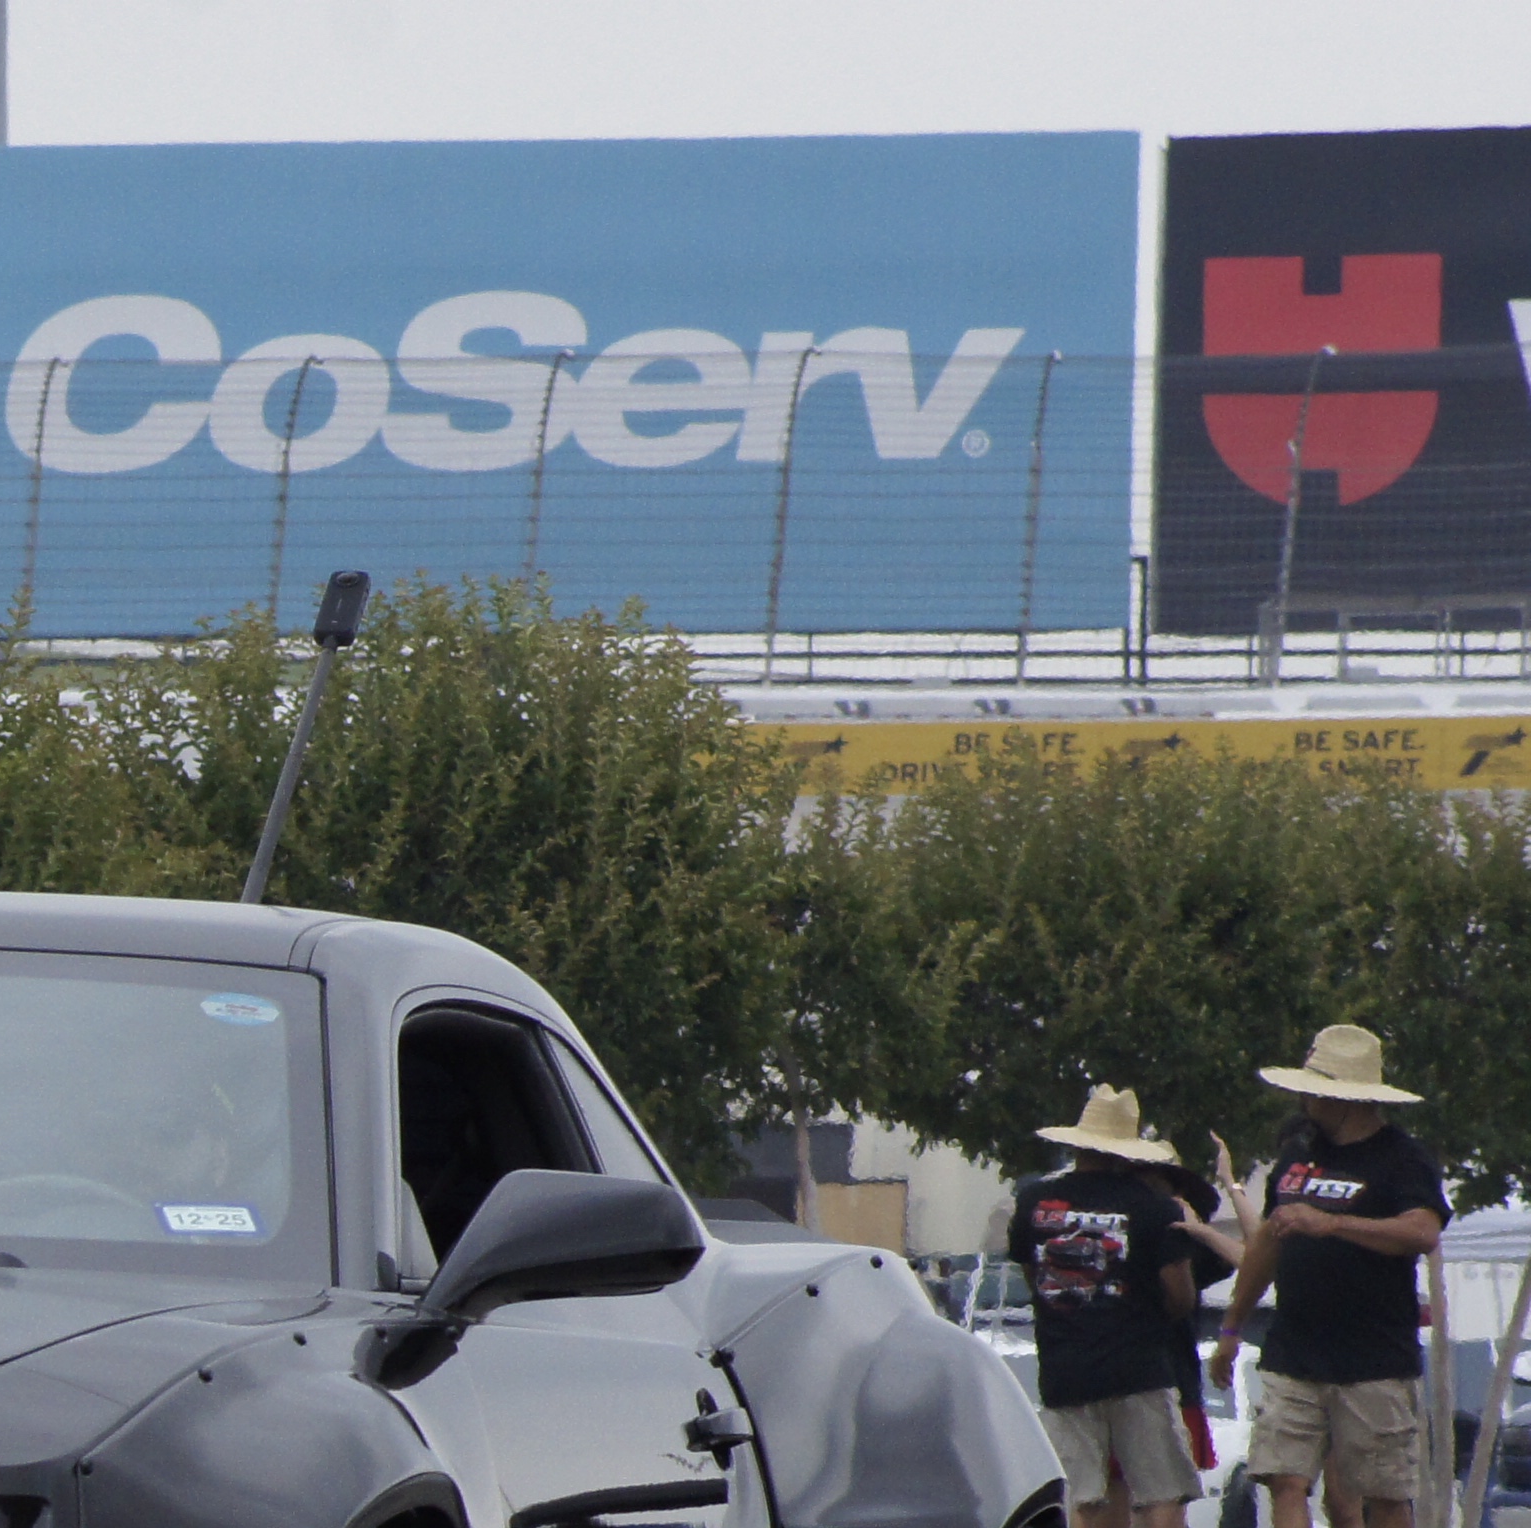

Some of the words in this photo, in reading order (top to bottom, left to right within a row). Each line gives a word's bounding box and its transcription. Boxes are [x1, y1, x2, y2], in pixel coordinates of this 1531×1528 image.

[1295, 729, 1331, 752] BE
[883, 761, 967, 784] DRIV
[1302, 1177, 1365, 1200] FEST
